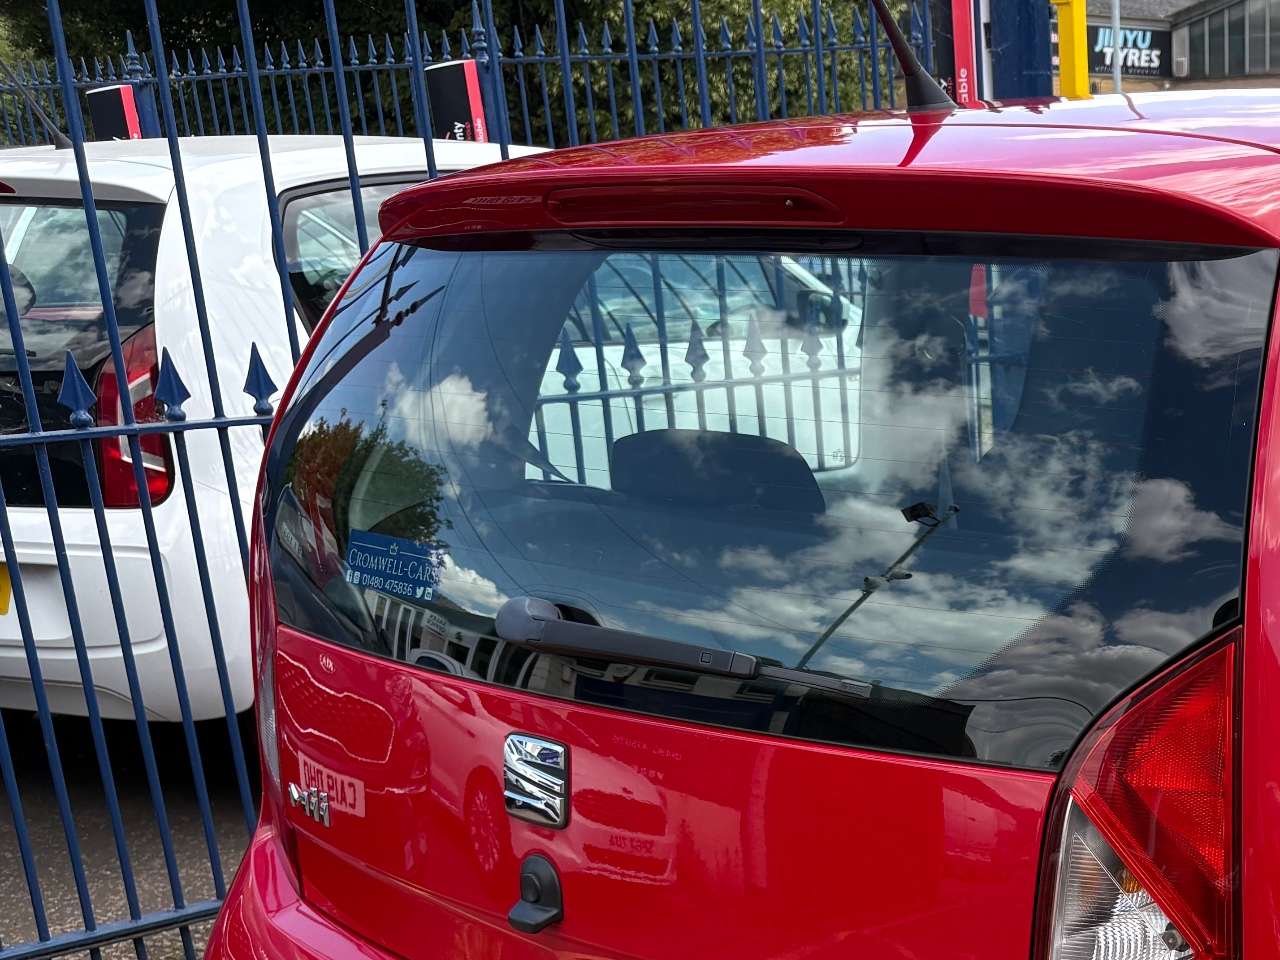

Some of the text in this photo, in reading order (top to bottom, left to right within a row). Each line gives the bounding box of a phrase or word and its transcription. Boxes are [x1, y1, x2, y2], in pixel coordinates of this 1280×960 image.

[1103, 47, 1161, 67] TYRES
[362, 573, 413, 597] 01480 475836
